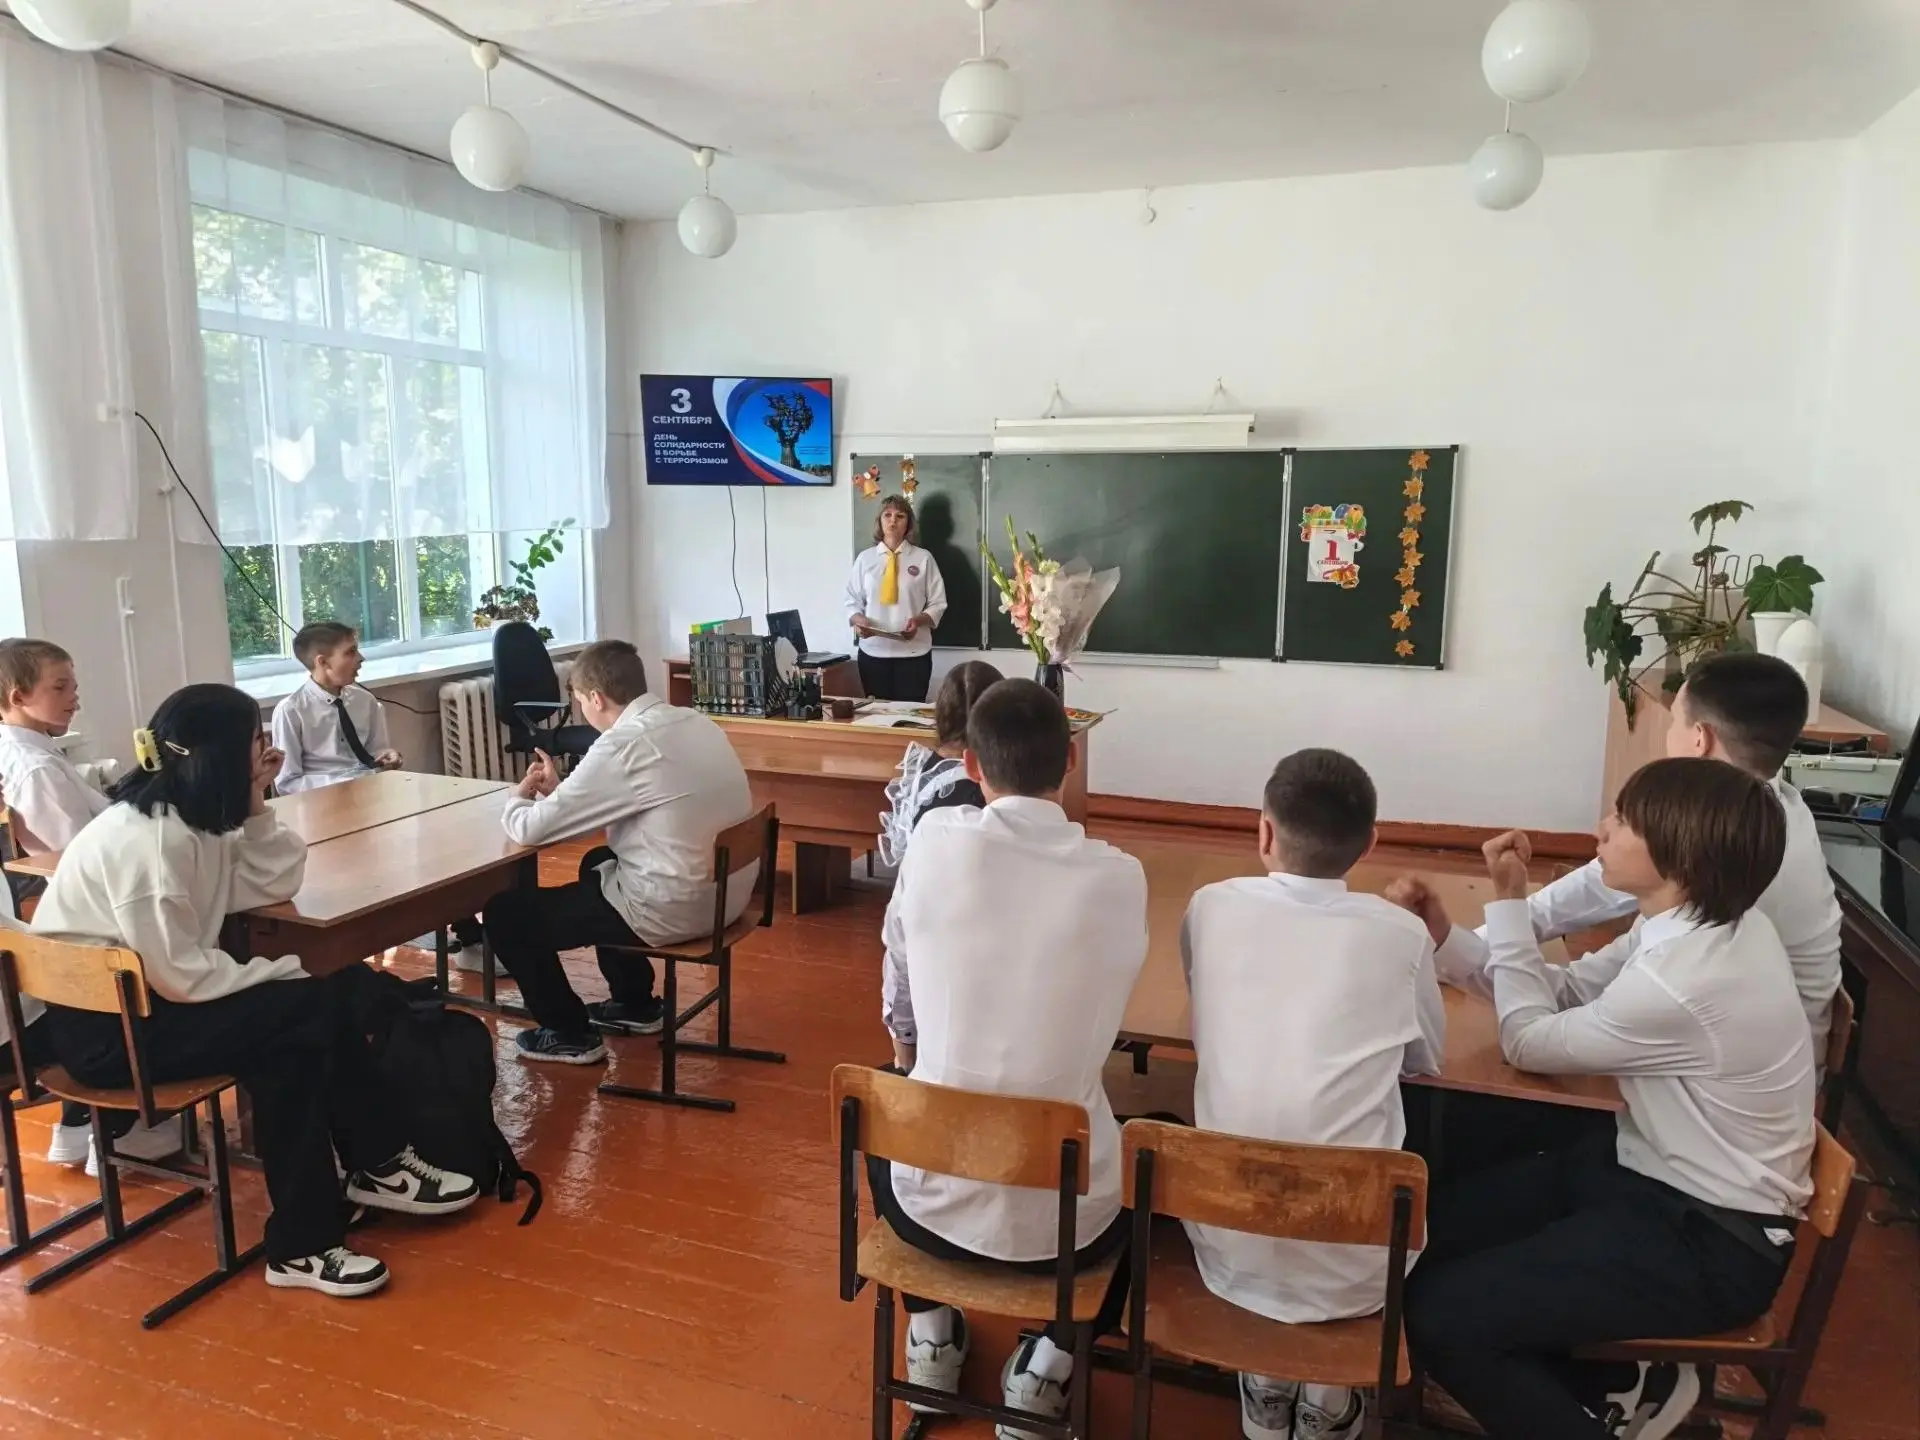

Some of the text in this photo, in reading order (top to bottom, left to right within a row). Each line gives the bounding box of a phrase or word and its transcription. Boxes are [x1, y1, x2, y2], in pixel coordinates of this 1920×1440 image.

[671, 388, 692, 413] 3
[653, 416, 712, 425] СЕНТЯБРЯ
[1325, 540, 1340, 560] 1
